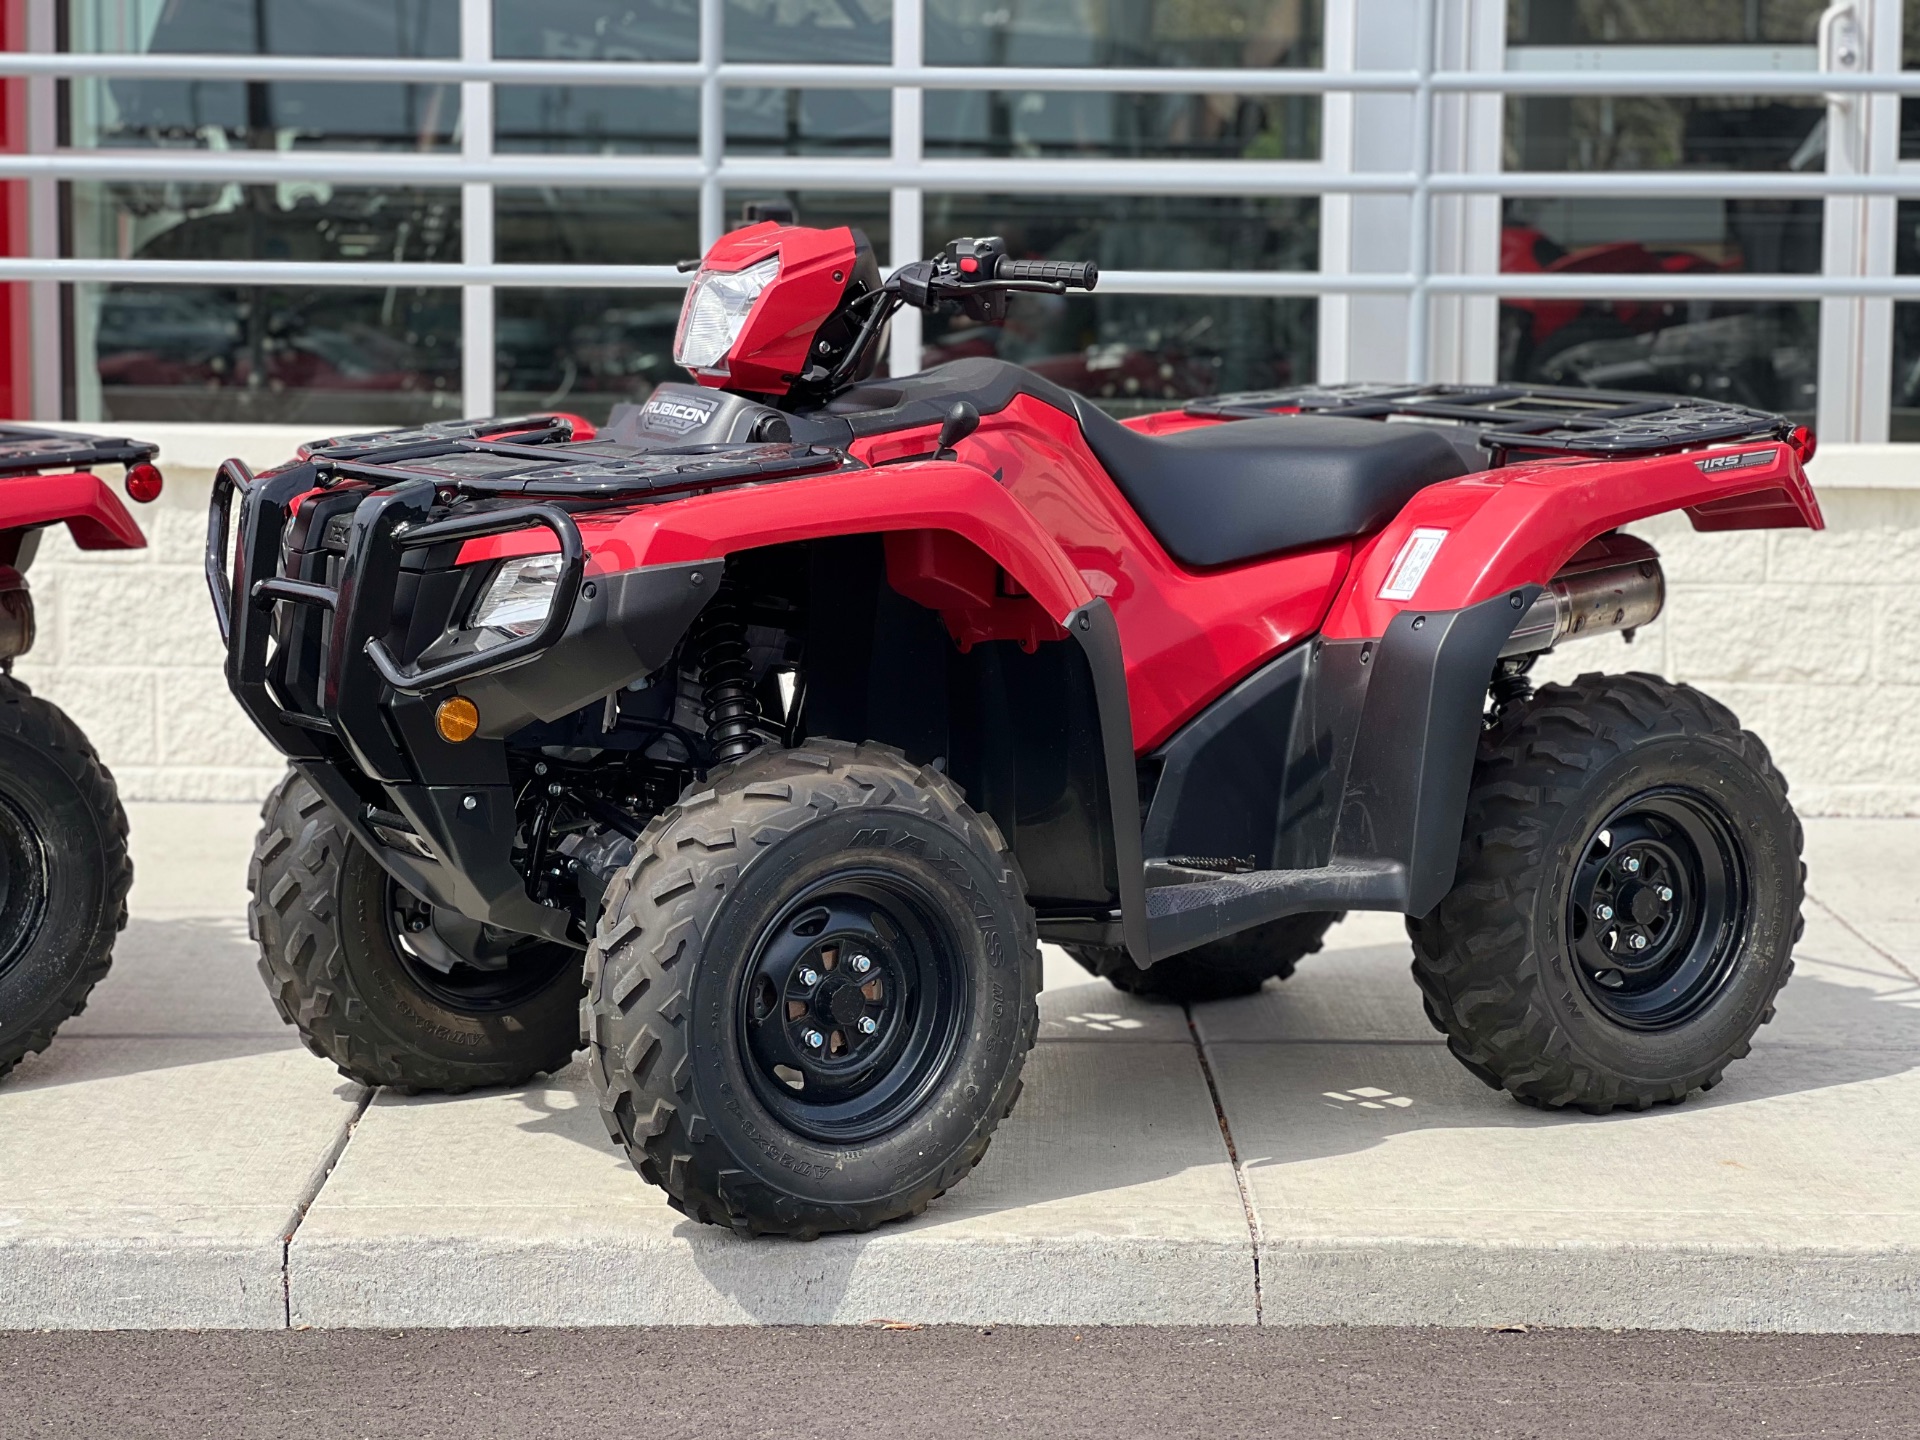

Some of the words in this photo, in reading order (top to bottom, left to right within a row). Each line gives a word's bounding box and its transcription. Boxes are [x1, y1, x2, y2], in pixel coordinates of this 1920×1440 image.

[645, 402, 711, 424] RUBICON
[1704, 455, 1740, 469] IRS
[846, 828, 1005, 967] MAXXIS
